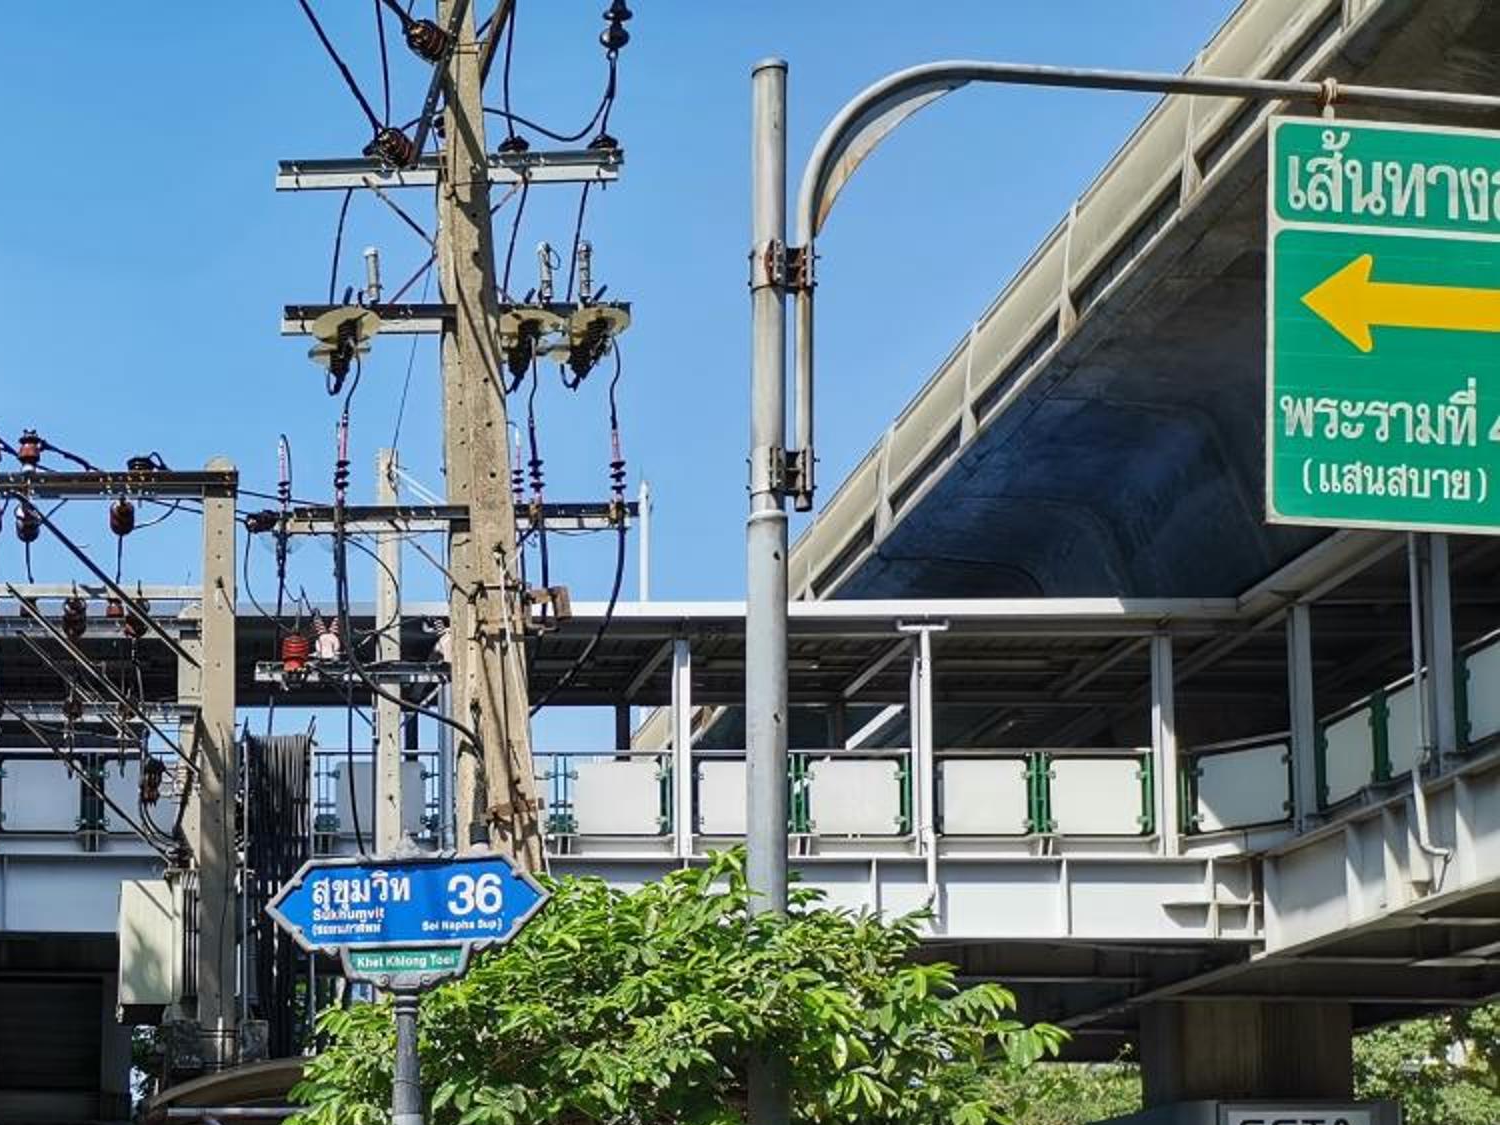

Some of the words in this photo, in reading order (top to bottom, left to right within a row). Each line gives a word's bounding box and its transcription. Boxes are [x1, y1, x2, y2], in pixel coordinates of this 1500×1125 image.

[1287, 130, 1500, 222] เส้นทาง
[1280, 377, 1477, 447] พระรามที่
[1302, 457, 1488, 503] (แสนสบาย)
[312, 869, 411, 912] สุขุมวิท
[447, 873, 503, 916] 36
[312, 906, 385, 922] Sukhumvit
[386, 955, 427, 969] Khlong
